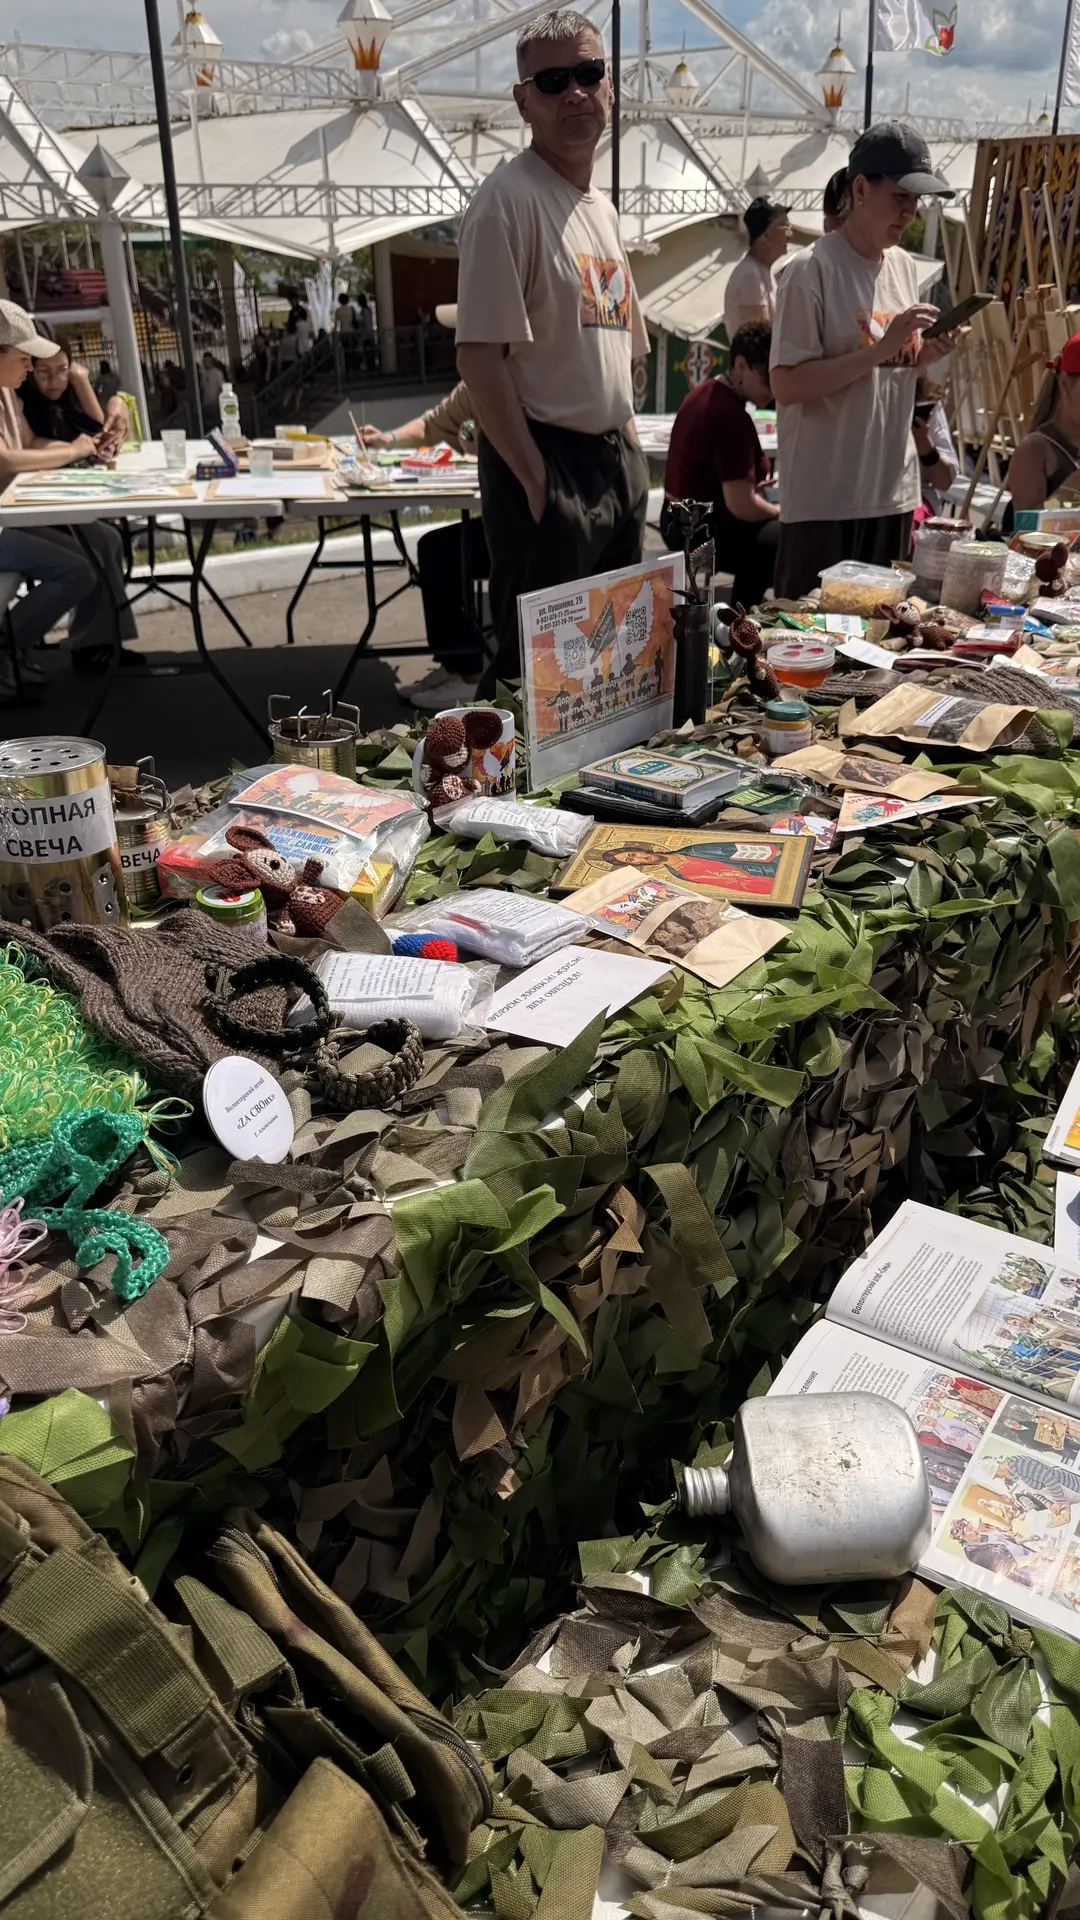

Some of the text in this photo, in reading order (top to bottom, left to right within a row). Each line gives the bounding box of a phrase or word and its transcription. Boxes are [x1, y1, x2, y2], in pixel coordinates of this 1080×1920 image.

[2, 798, 96, 826] ОПНАЯ
[6, 835, 83, 857] СВЕЧА
[120, 848, 161, 868] ВЕЧА
[487, 998, 522, 1022] ВЕРИМ!
[521, 975, 556, 1000] ЛЮБИМ!
[254, 1076, 265, 1089] штаб
[798, 1371, 819, 1395] оселение
